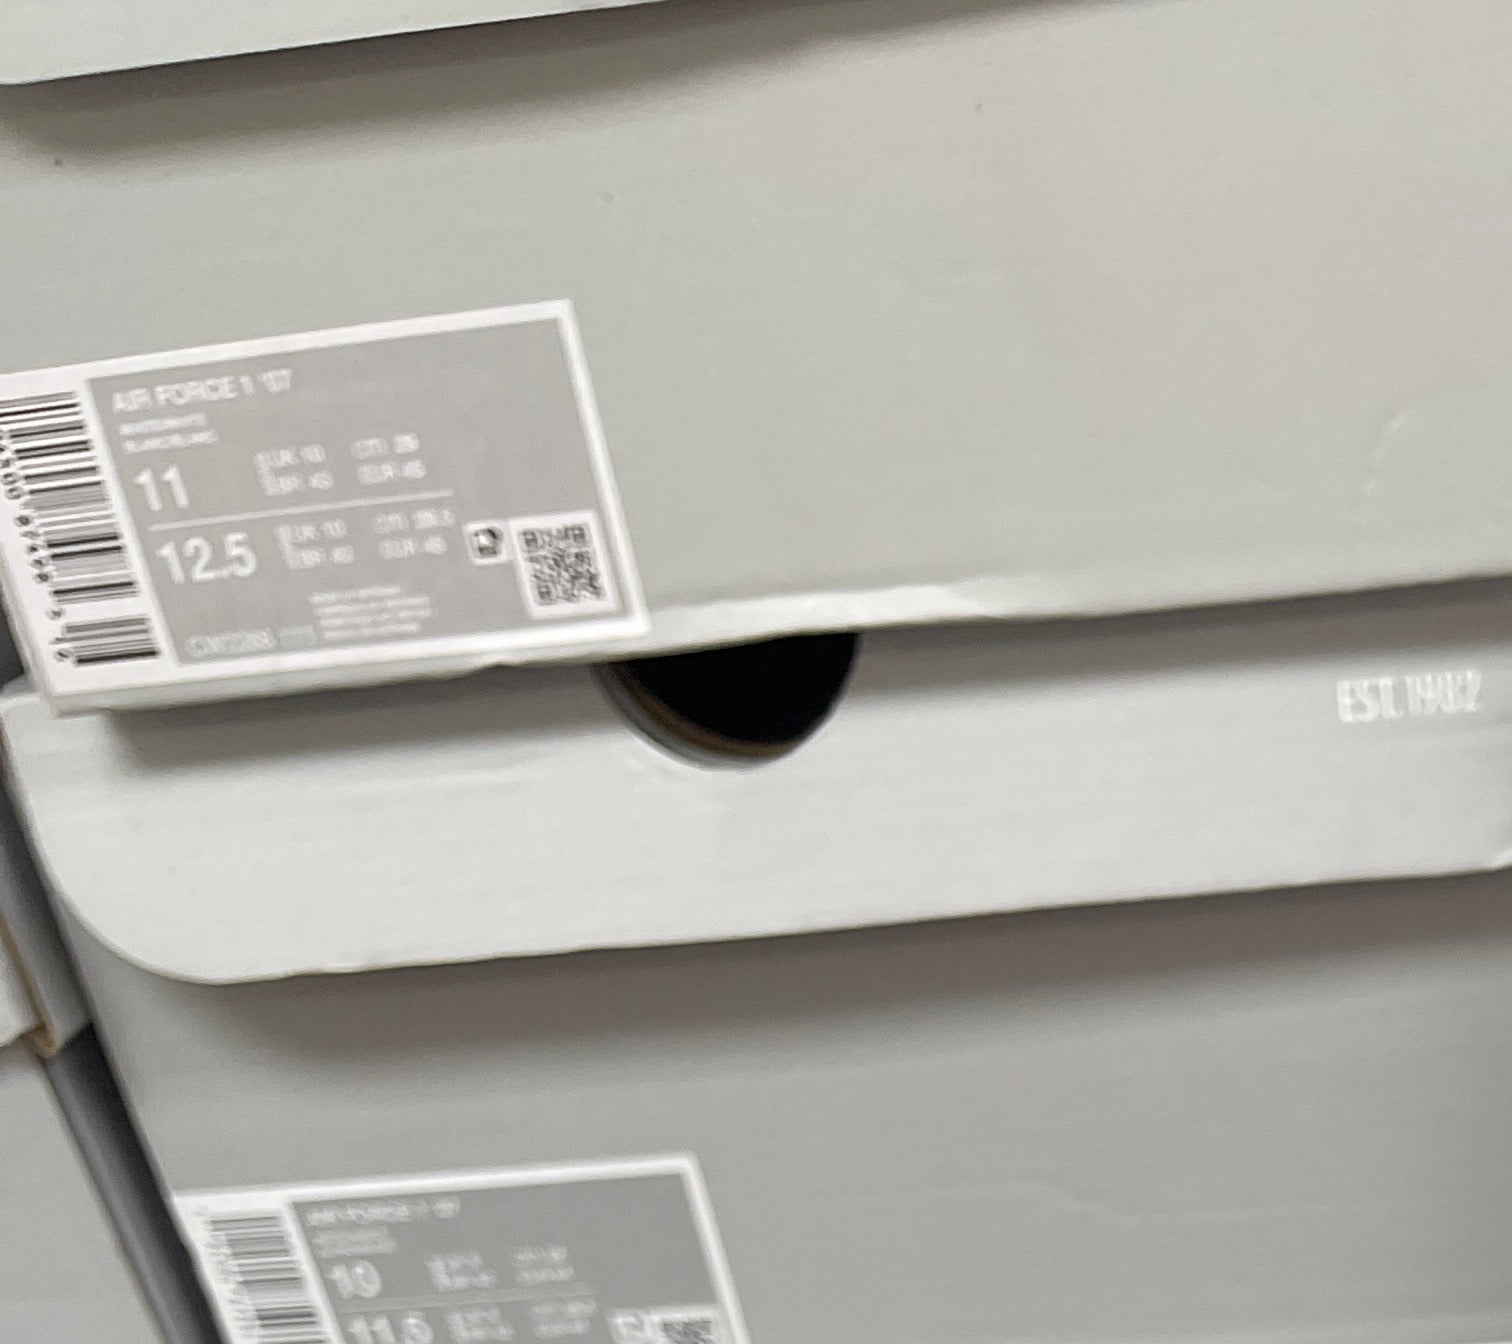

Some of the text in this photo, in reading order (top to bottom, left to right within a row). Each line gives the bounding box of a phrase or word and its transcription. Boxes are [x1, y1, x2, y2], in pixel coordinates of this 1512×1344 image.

[154, 378, 238, 406] FORCE
[133, 464, 190, 513] 11
[155, 531, 258, 584] 12.5
[328, 1258, 383, 1300] 10
